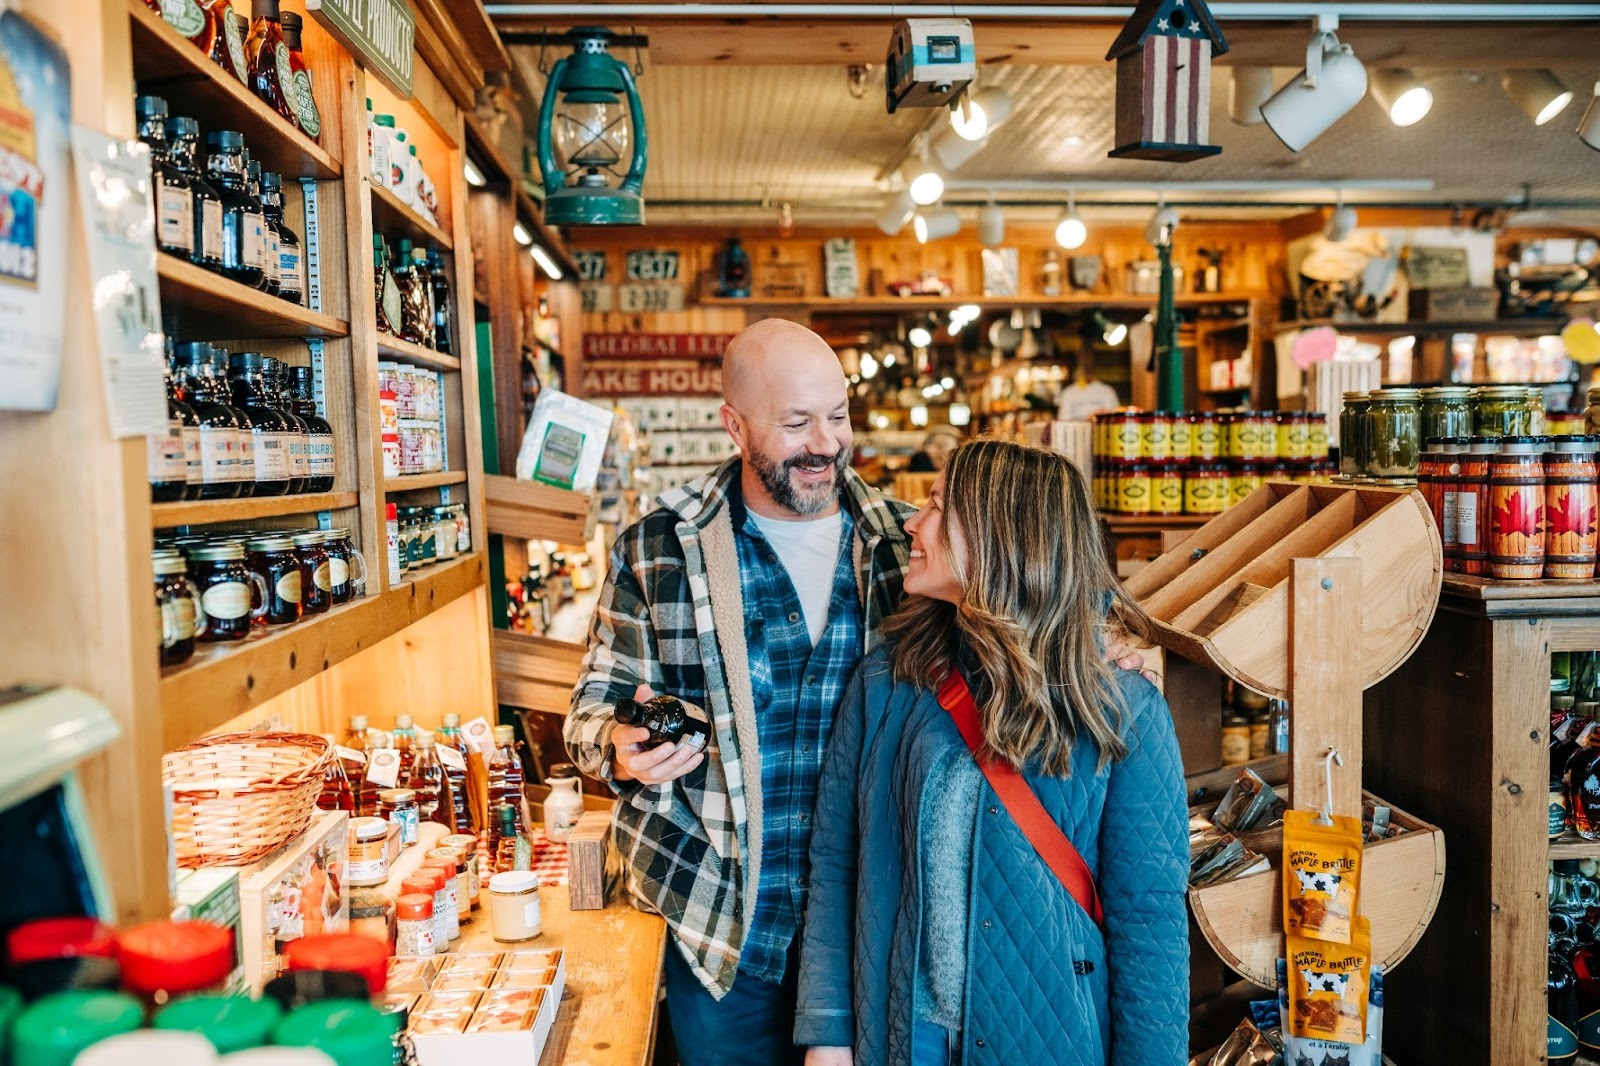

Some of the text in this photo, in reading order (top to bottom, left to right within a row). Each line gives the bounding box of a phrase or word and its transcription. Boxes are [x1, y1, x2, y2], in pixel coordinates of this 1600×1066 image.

[366, 0, 412, 79] PRODUCTS
[582, 370, 723, 393] AKE HOUS
[1289, 851, 1317, 859] VERMONT
[1291, 857, 1356, 870] MAPLE BRITTLE
[1293, 951, 1322, 959] VERMONT
[1295, 956, 1363, 970] MAPLE BRITTLE
[1324, 1041, 1350, 1051] l'érable
[1547, 1037, 1563, 1045] yrup
